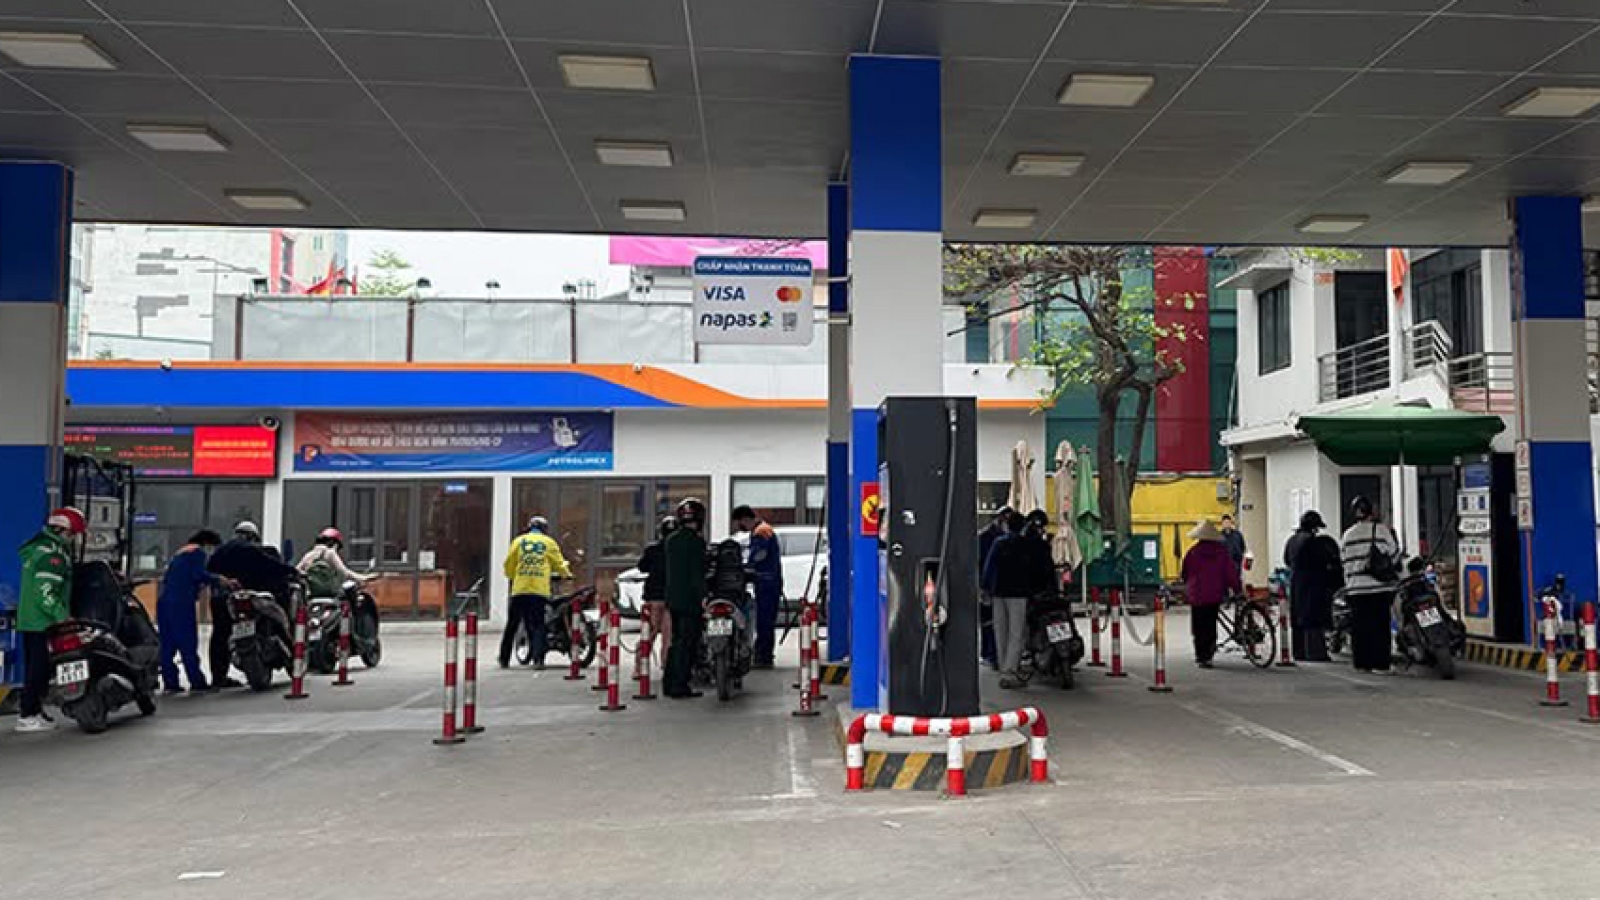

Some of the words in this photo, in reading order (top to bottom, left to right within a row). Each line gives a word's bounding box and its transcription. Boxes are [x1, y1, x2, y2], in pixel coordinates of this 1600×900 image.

[752, 262, 782, 272] THANH
[703, 286, 746, 301] VISA
[700, 313, 757, 331] napas
